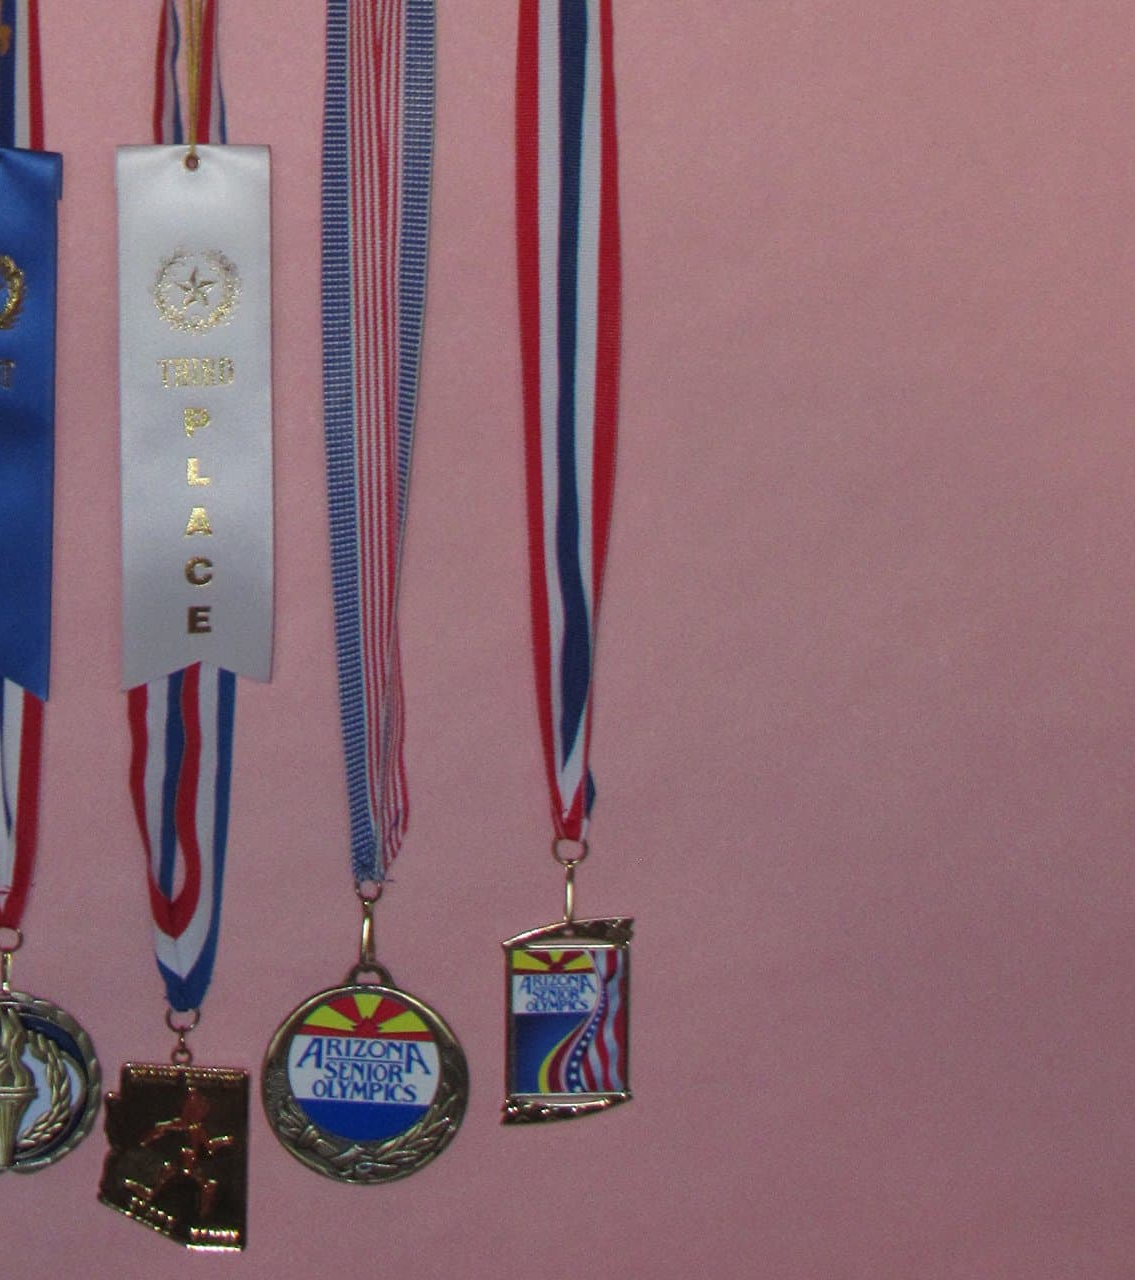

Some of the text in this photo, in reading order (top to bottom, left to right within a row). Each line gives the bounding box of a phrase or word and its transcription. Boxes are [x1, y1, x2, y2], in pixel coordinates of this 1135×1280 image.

[156, 356, 236, 389] THIRD
[184, 406, 214, 634] PLACE
[519, 974, 596, 995] ARIZONA
[296, 1037, 431, 1075] ARIZONA
[323, 1060, 403, 1083] SENIOR
[311, 1079, 418, 1103] OLYMPICS
